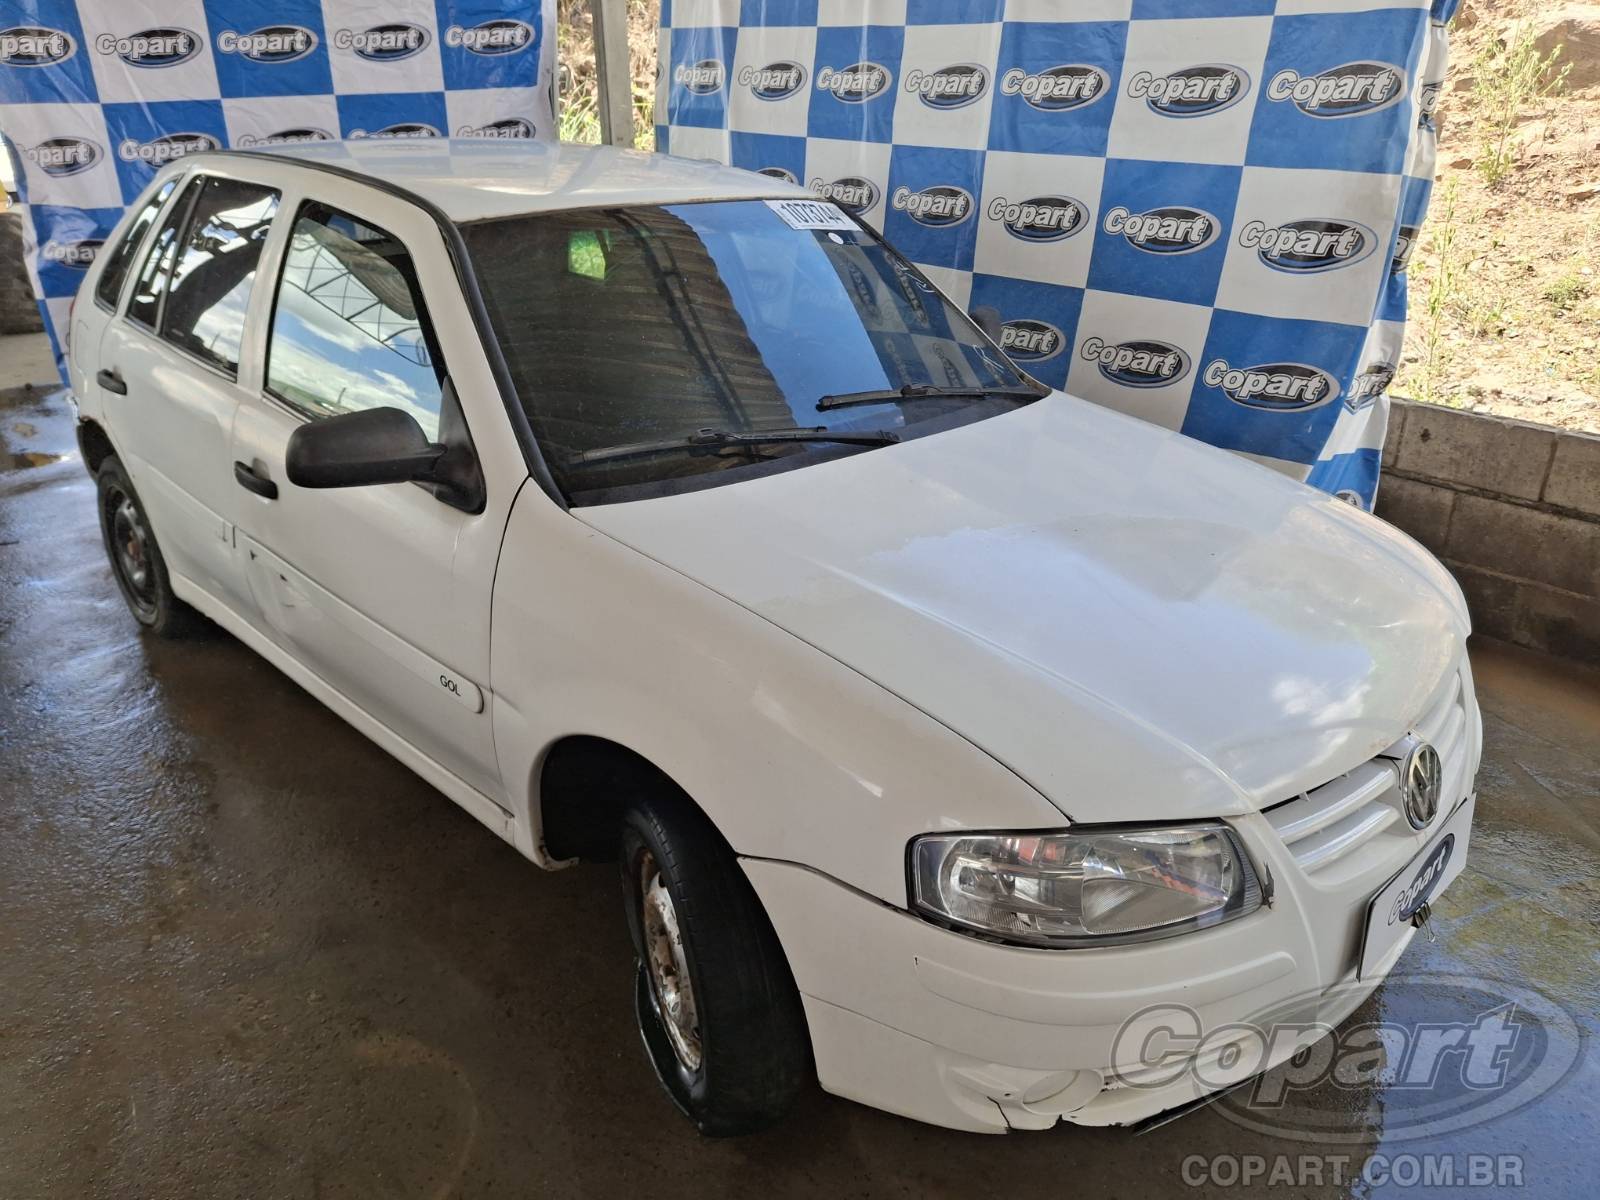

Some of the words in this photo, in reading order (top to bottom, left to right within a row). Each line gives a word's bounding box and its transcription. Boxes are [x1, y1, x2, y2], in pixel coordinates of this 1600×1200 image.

[0, 32, 66, 58] part
[96, 33, 190, 59] Copart
[217, 30, 312, 57] Copart
[334, 28, 423, 55] Copart
[444, 24, 527, 51] Copart
[674, 64, 724, 90] Copart
[738, 65, 801, 93] Copart
[816, 65, 883, 94] Copart
[905, 68, 986, 99] Copart
[1001, 67, 1101, 104] Copart
[1127, 70, 1238, 107] Copart
[1266, 68, 1396, 111] Copart
[780, 202, 847, 224] 1073744
[892, 185, 969, 218] Copart
[988, 197, 1078, 230] Copart
[1104, 206, 1208, 244] Copart
[42, 240, 96, 266] Copa
[1239, 220, 1360, 260] Copart
[1000, 325, 1056, 353] part
[1081, 336, 1180, 379] Copart
[1203, 359, 1328, 403] Copart
[440, 675, 461, 696] GOL
[1388, 846, 1448, 927] Copart
